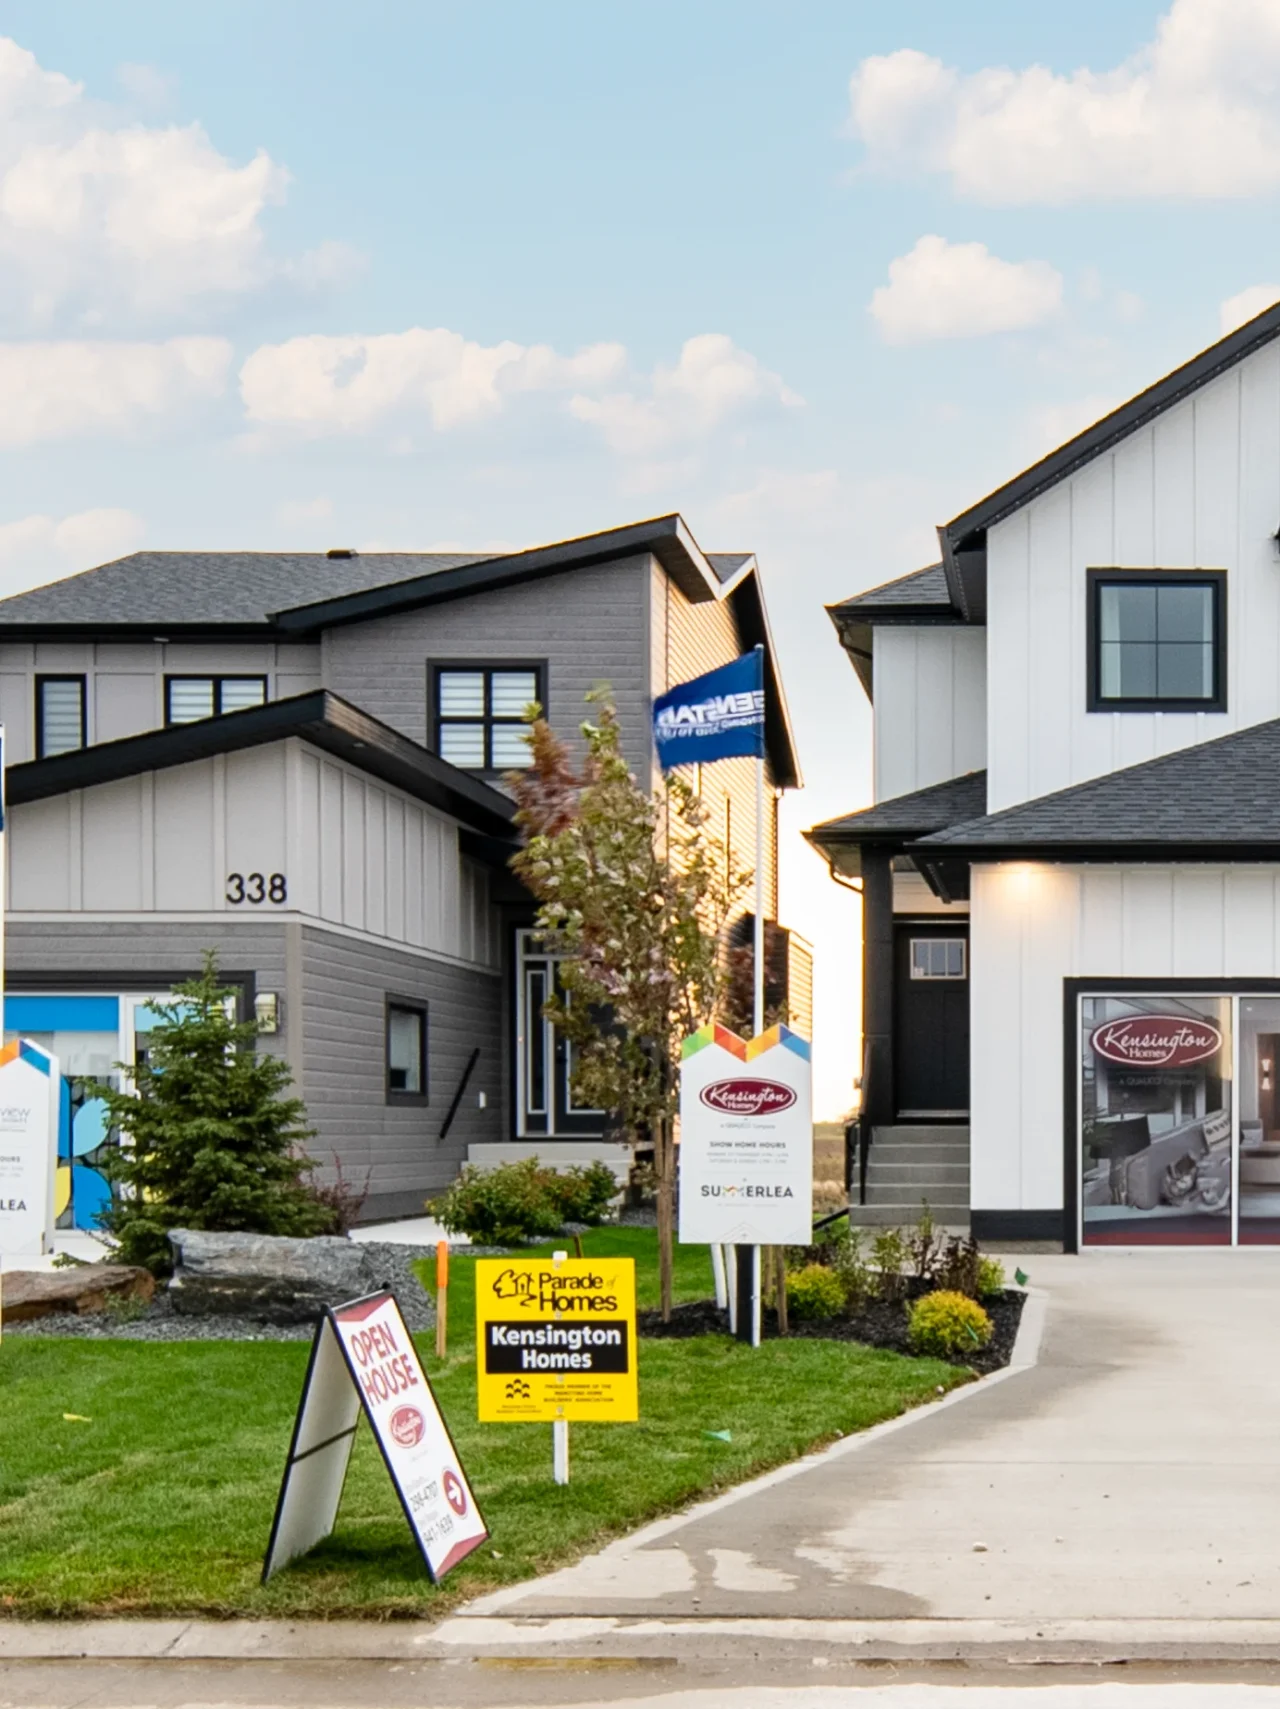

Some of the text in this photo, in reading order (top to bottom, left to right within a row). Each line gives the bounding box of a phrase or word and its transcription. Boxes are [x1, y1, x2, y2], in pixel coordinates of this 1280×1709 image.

[226, 872, 287, 904] 338
[1104, 1023, 1214, 1058] Kensington
[1129, 1047, 1167, 1058] Homes
[709, 1084, 789, 1110] Kensington
[539, 1272, 603, 1290] Parade
[539, 1291, 618, 1312] Homes
[350, 1320, 399, 1367] OPEN
[491, 1325, 622, 1350] Kensington
[522, 1350, 592, 1369] Homes
[360, 1353, 418, 1407] HOUSE
